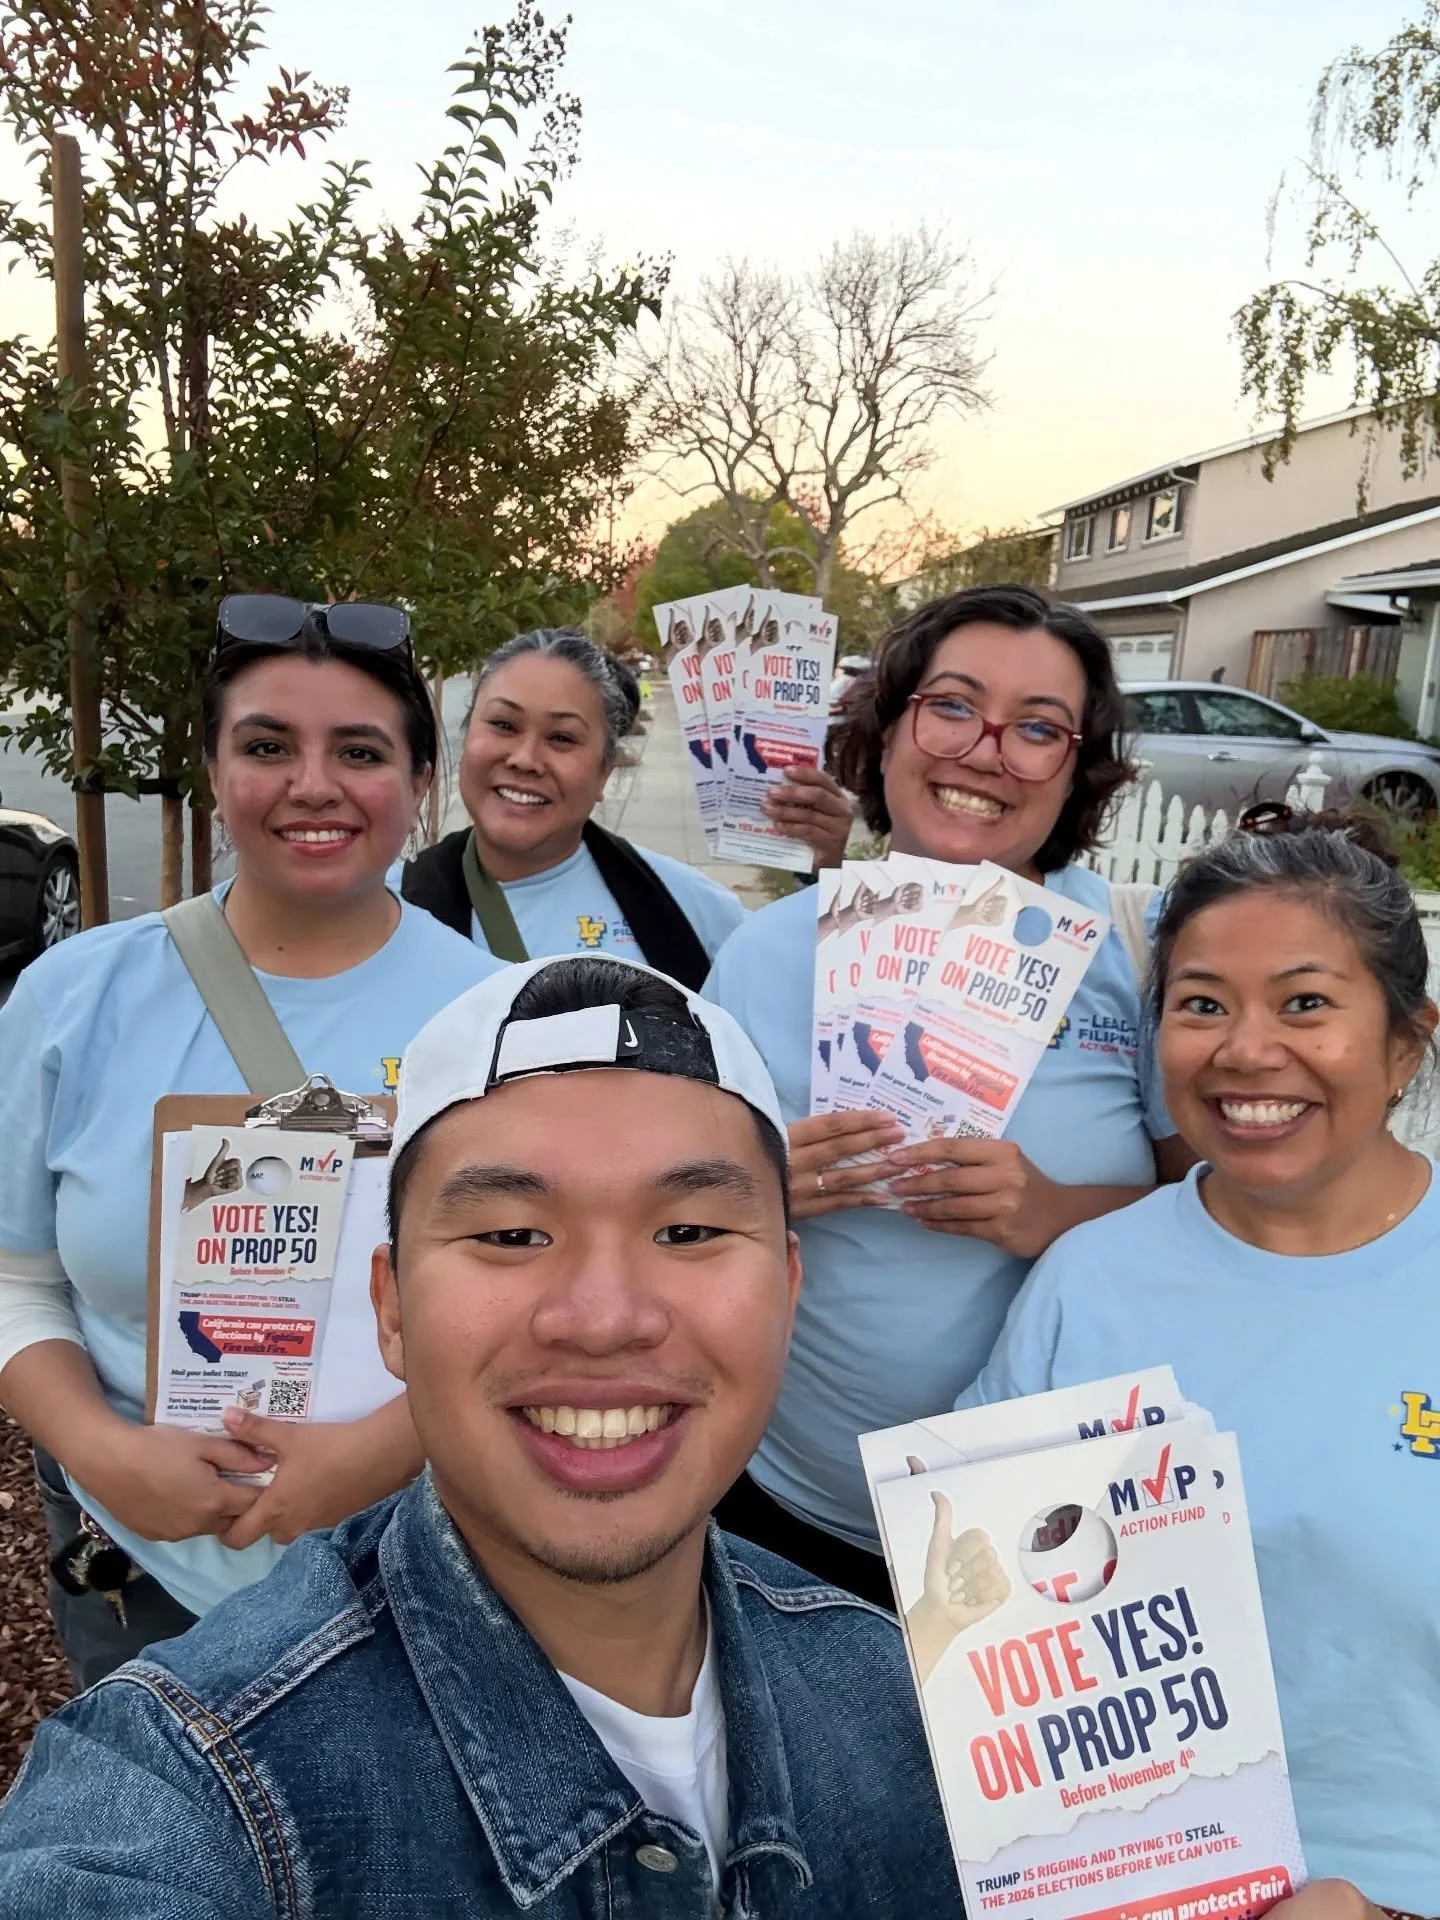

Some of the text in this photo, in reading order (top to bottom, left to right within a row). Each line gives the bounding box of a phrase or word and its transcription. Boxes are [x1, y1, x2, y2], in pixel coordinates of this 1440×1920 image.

[763, 654, 820, 681] VOTE YES!
[682, 681, 704, 704] ON
[712, 680, 732, 702] ON
[755, 679, 821, 705] ON PROP 50
[894, 923, 942, 957] VOTE
[876, 954, 903, 982] ON
[964, 933, 1016, 976] VOTE
[1014, 953, 1060, 993] YES!
[940, 961, 971, 992] ON
[967, 971, 1021, 1010] PROP
[1017, 992, 1048, 1022] 50
[300, 1149, 343, 1173] MVP
[212, 1205, 319, 1233] VOTE YES!
[197, 1238, 317, 1264] ON PROP 50
[202, 1318, 246, 1329] California
[1108, 1443, 1196, 1516] MVP
[1119, 1505, 1206, 1538] ACTION FUND
[967, 1586, 1204, 1717] VOTE YES!
[969, 1666, 1230, 1801] ON PROP 50
[1059, 1746, 1196, 1809] Before November 4th
[976, 1821, 1225, 1894] TRUMP IS RIGGING AND TRYING TO STEAL
[980, 1836, 1242, 1910] THE 2026 ELECTIONS BEFORE WE CAN VOTE.
[1178, 1885, 1247, 1920] protect
[1249, 1874, 1286, 1906] Fair
